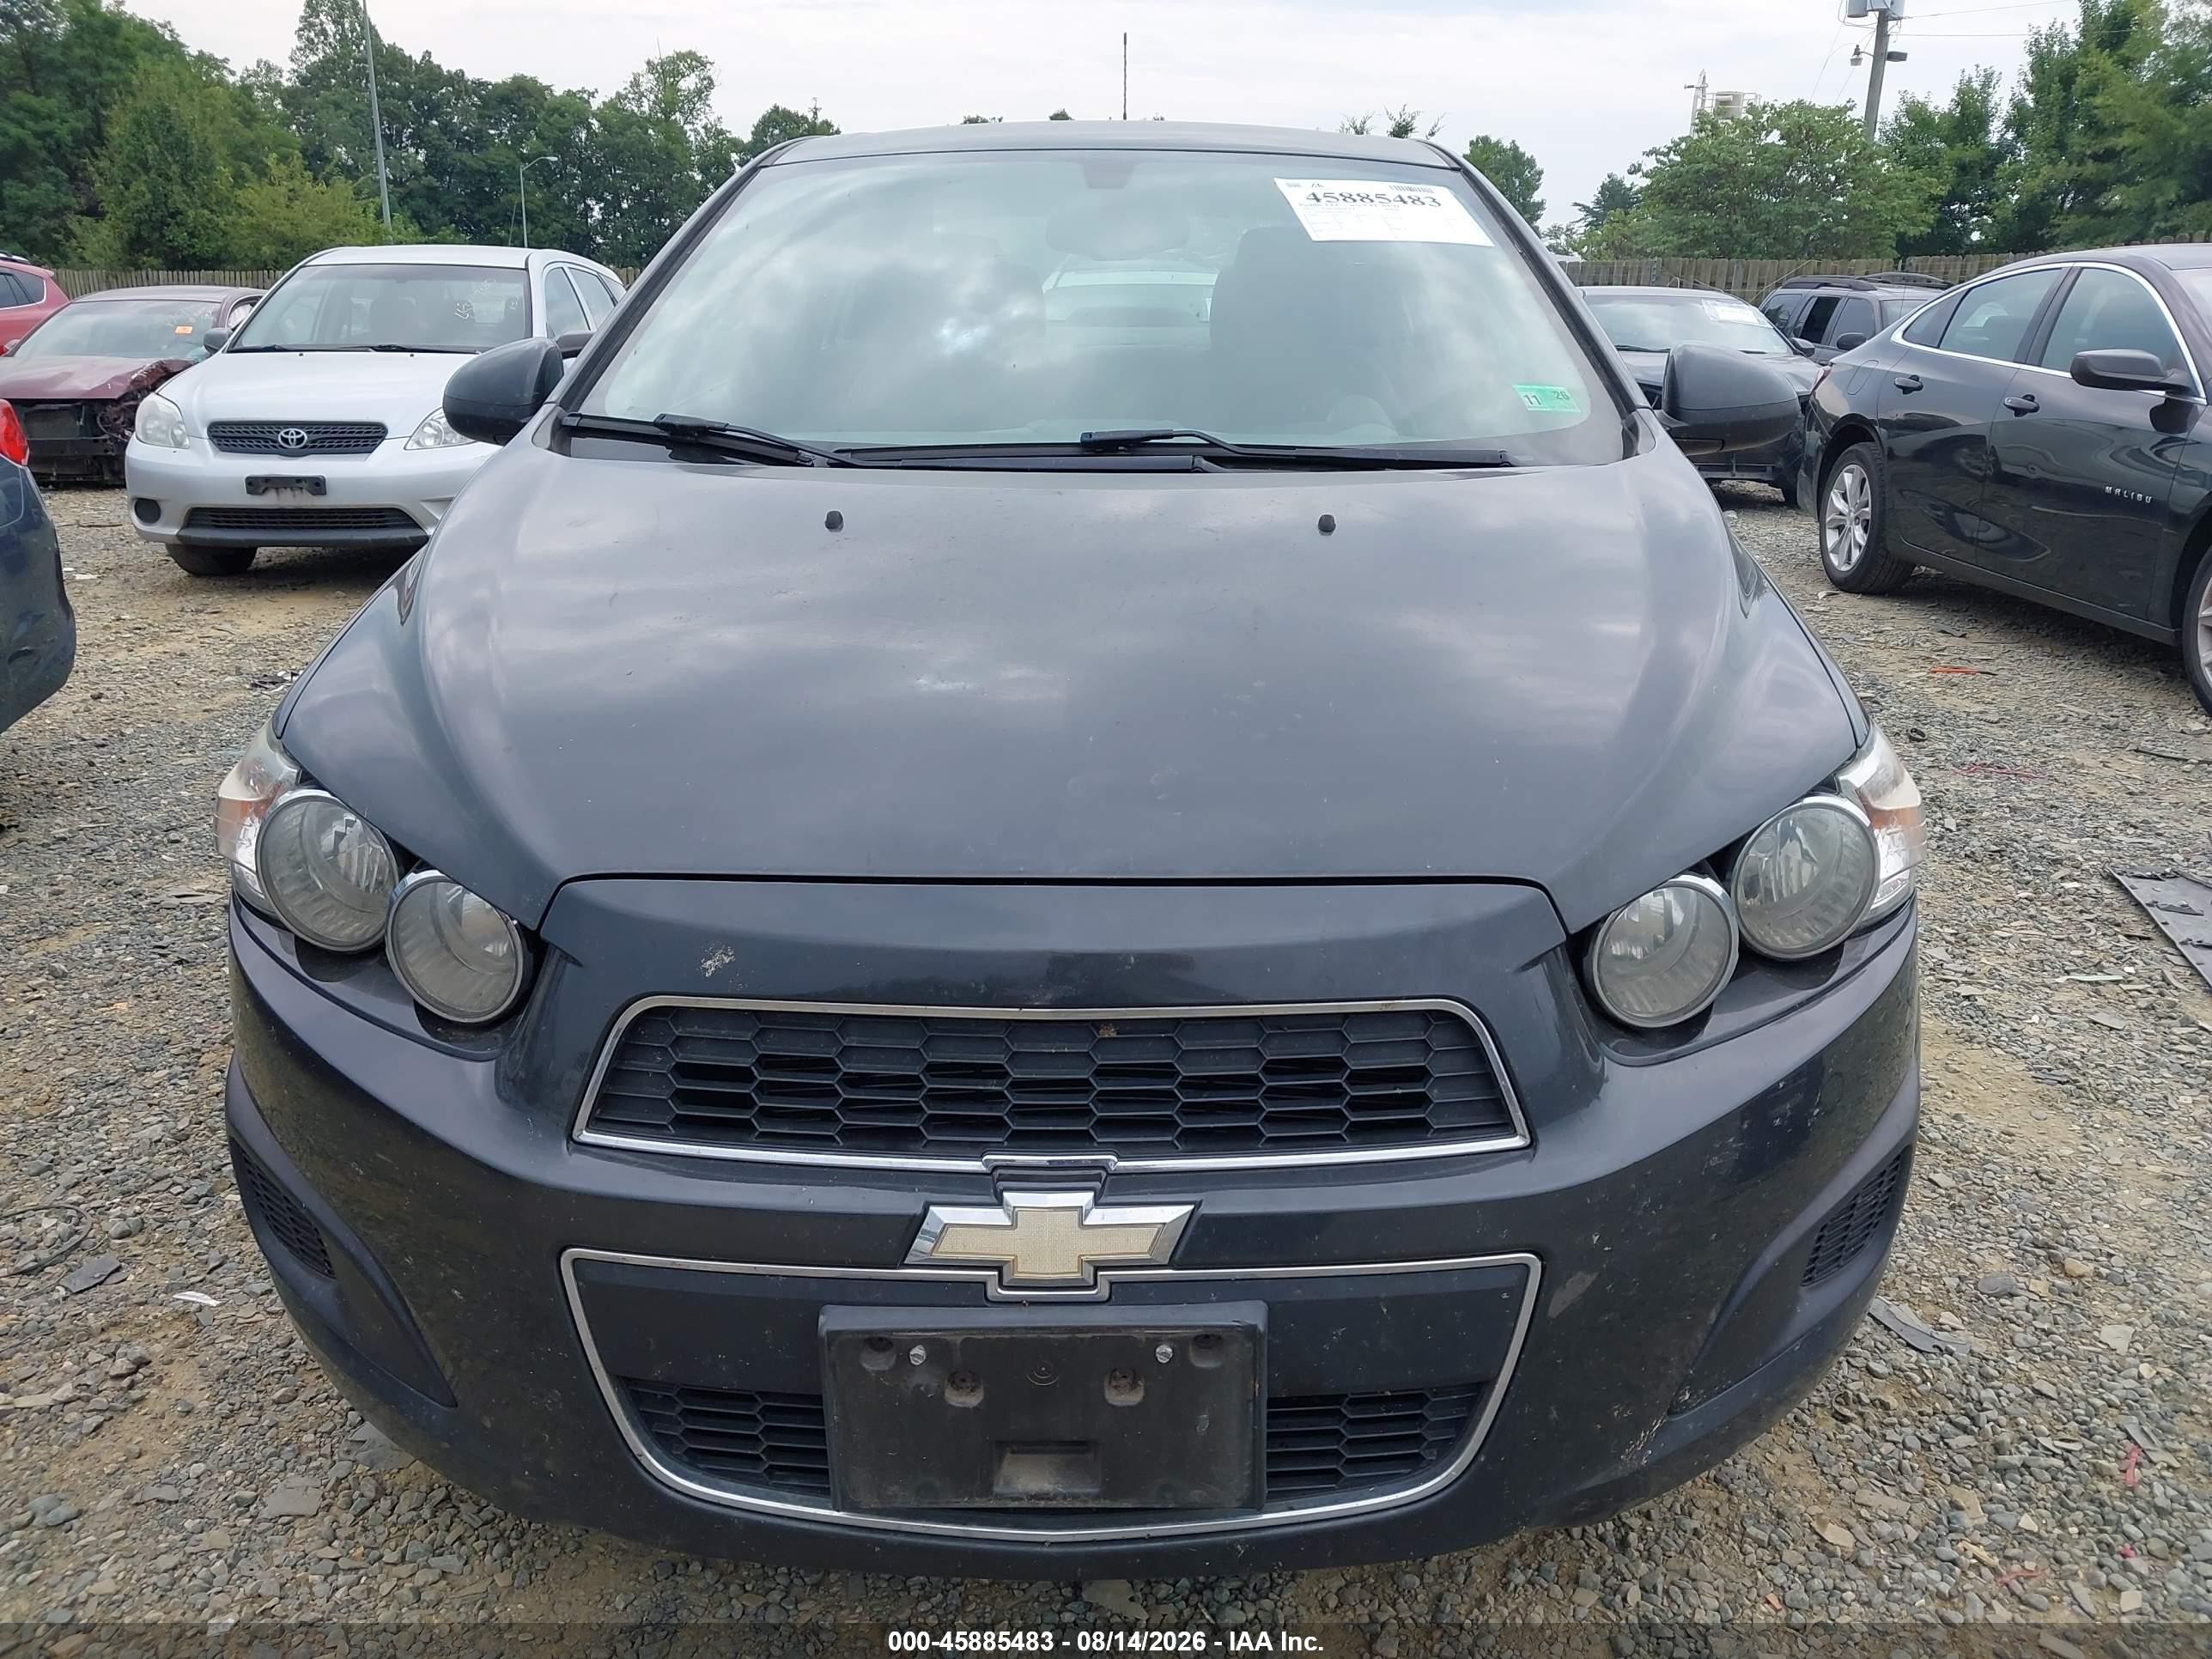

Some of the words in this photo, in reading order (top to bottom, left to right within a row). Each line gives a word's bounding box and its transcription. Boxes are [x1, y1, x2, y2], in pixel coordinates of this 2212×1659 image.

[1306, 192, 1442, 207] 45885483
[1523, 395, 1541, 405] 11
[2106, 486, 2152, 503] MALIBU
